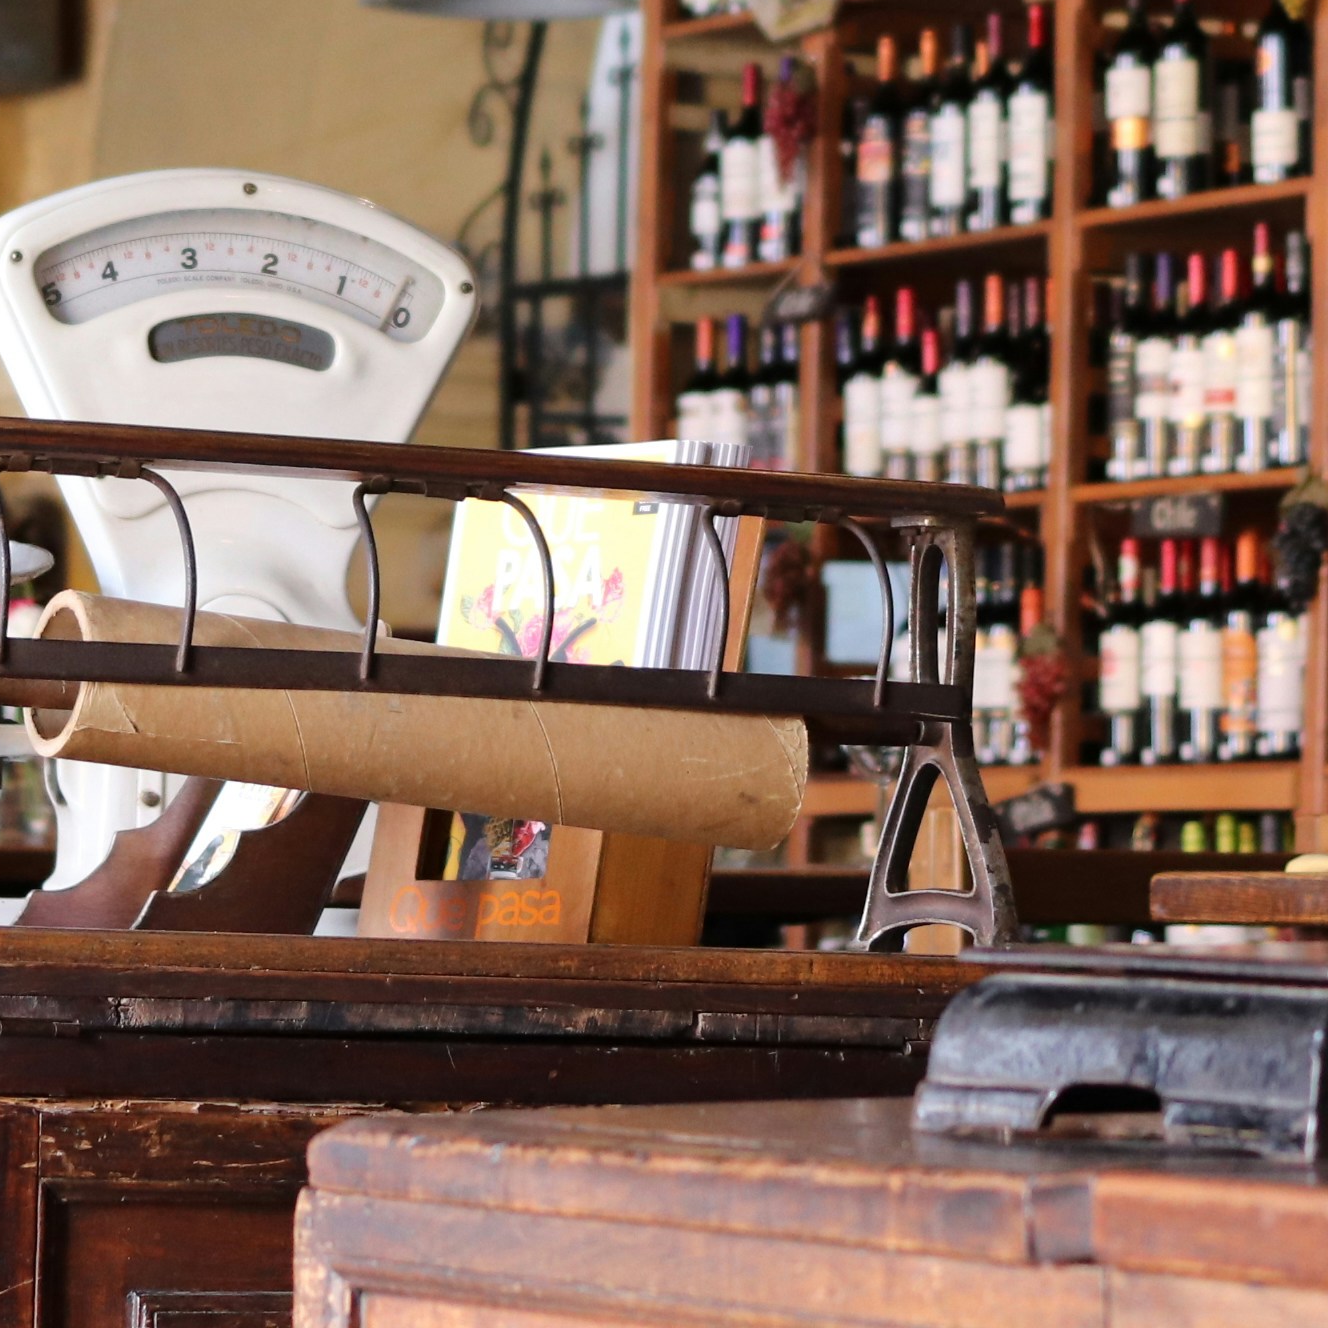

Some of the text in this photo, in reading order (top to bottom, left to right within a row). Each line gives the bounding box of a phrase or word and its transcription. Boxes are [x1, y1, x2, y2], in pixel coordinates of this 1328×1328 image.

[122, 250, 134, 260] 12
[204, 242, 215, 252] 12
[287, 252, 298, 263] 12
[183, 275, 204, 283] SCALE
[206, 275, 236, 283] COMPANY
[358, 277, 369, 289] 12
[41, 247, 411, 328] 5 4 3 2 1 0
[183, 317, 302, 345] TOLEDO
[240, 336, 273, 356] PESO
[492, 542, 604, 612] PASA
[389, 884, 562, 941] Que pasa
